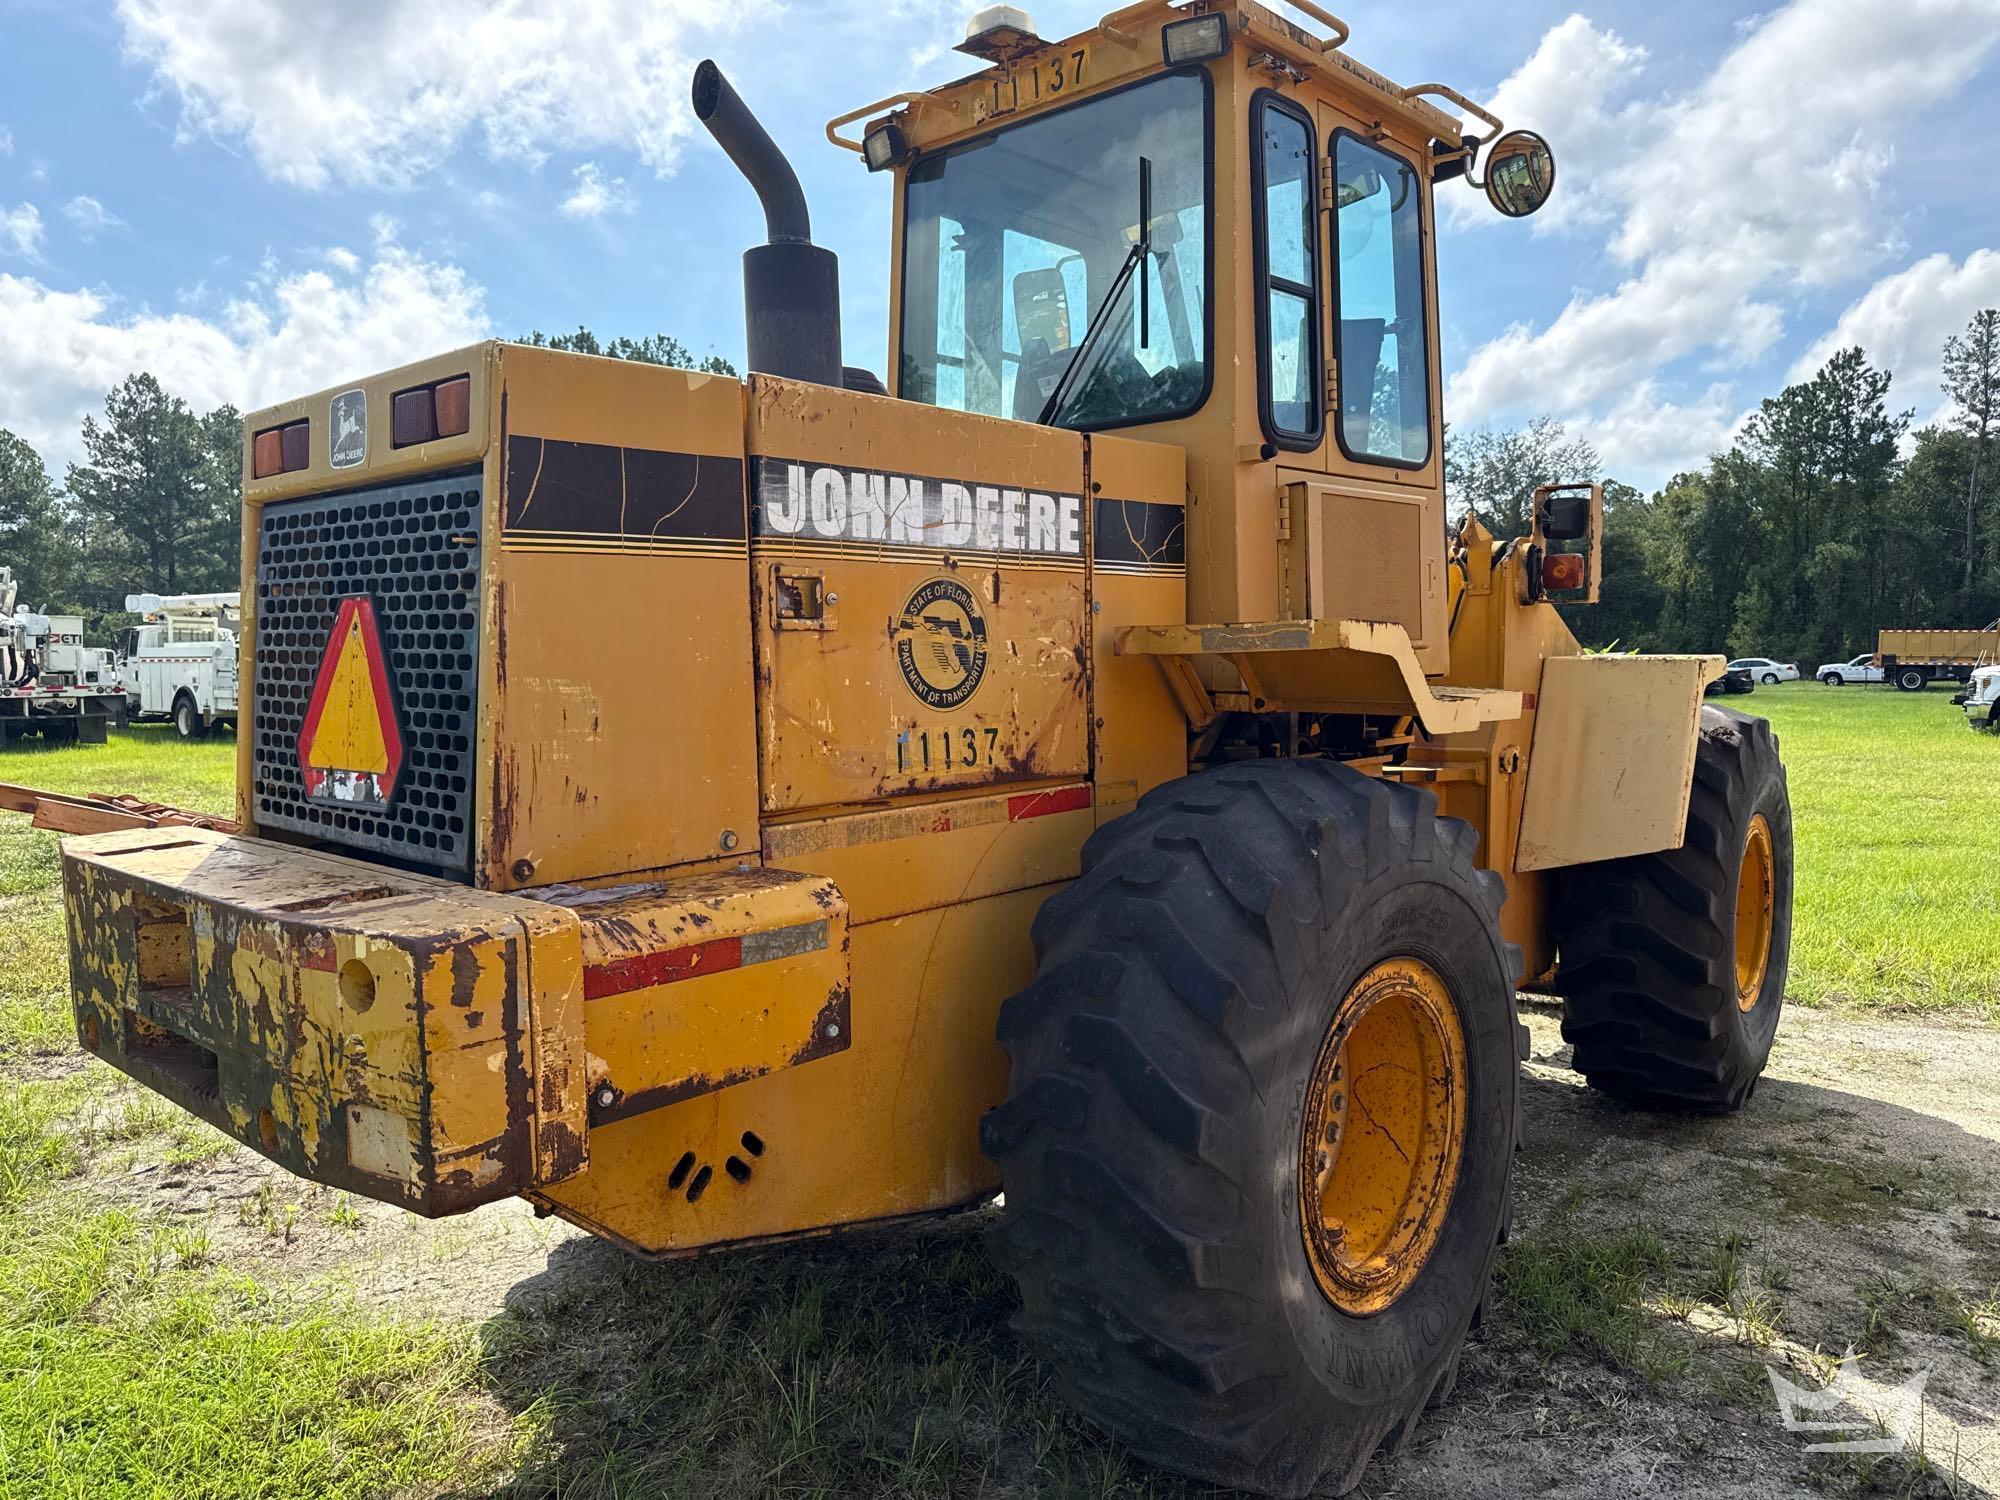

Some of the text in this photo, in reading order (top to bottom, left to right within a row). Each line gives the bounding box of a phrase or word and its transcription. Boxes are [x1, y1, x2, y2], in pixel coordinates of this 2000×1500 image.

[992, 49, 1086, 112] 11137
[767, 464, 1081, 553] JOHN DEERE
[910, 589, 933, 615] STATE
[934, 584, 946, 597] OF
[61, 633, 82, 645] ETI
[901, 634, 984, 704] EPARTMENT OF TRANSPORTATION
[897, 727, 999, 774] 11137
